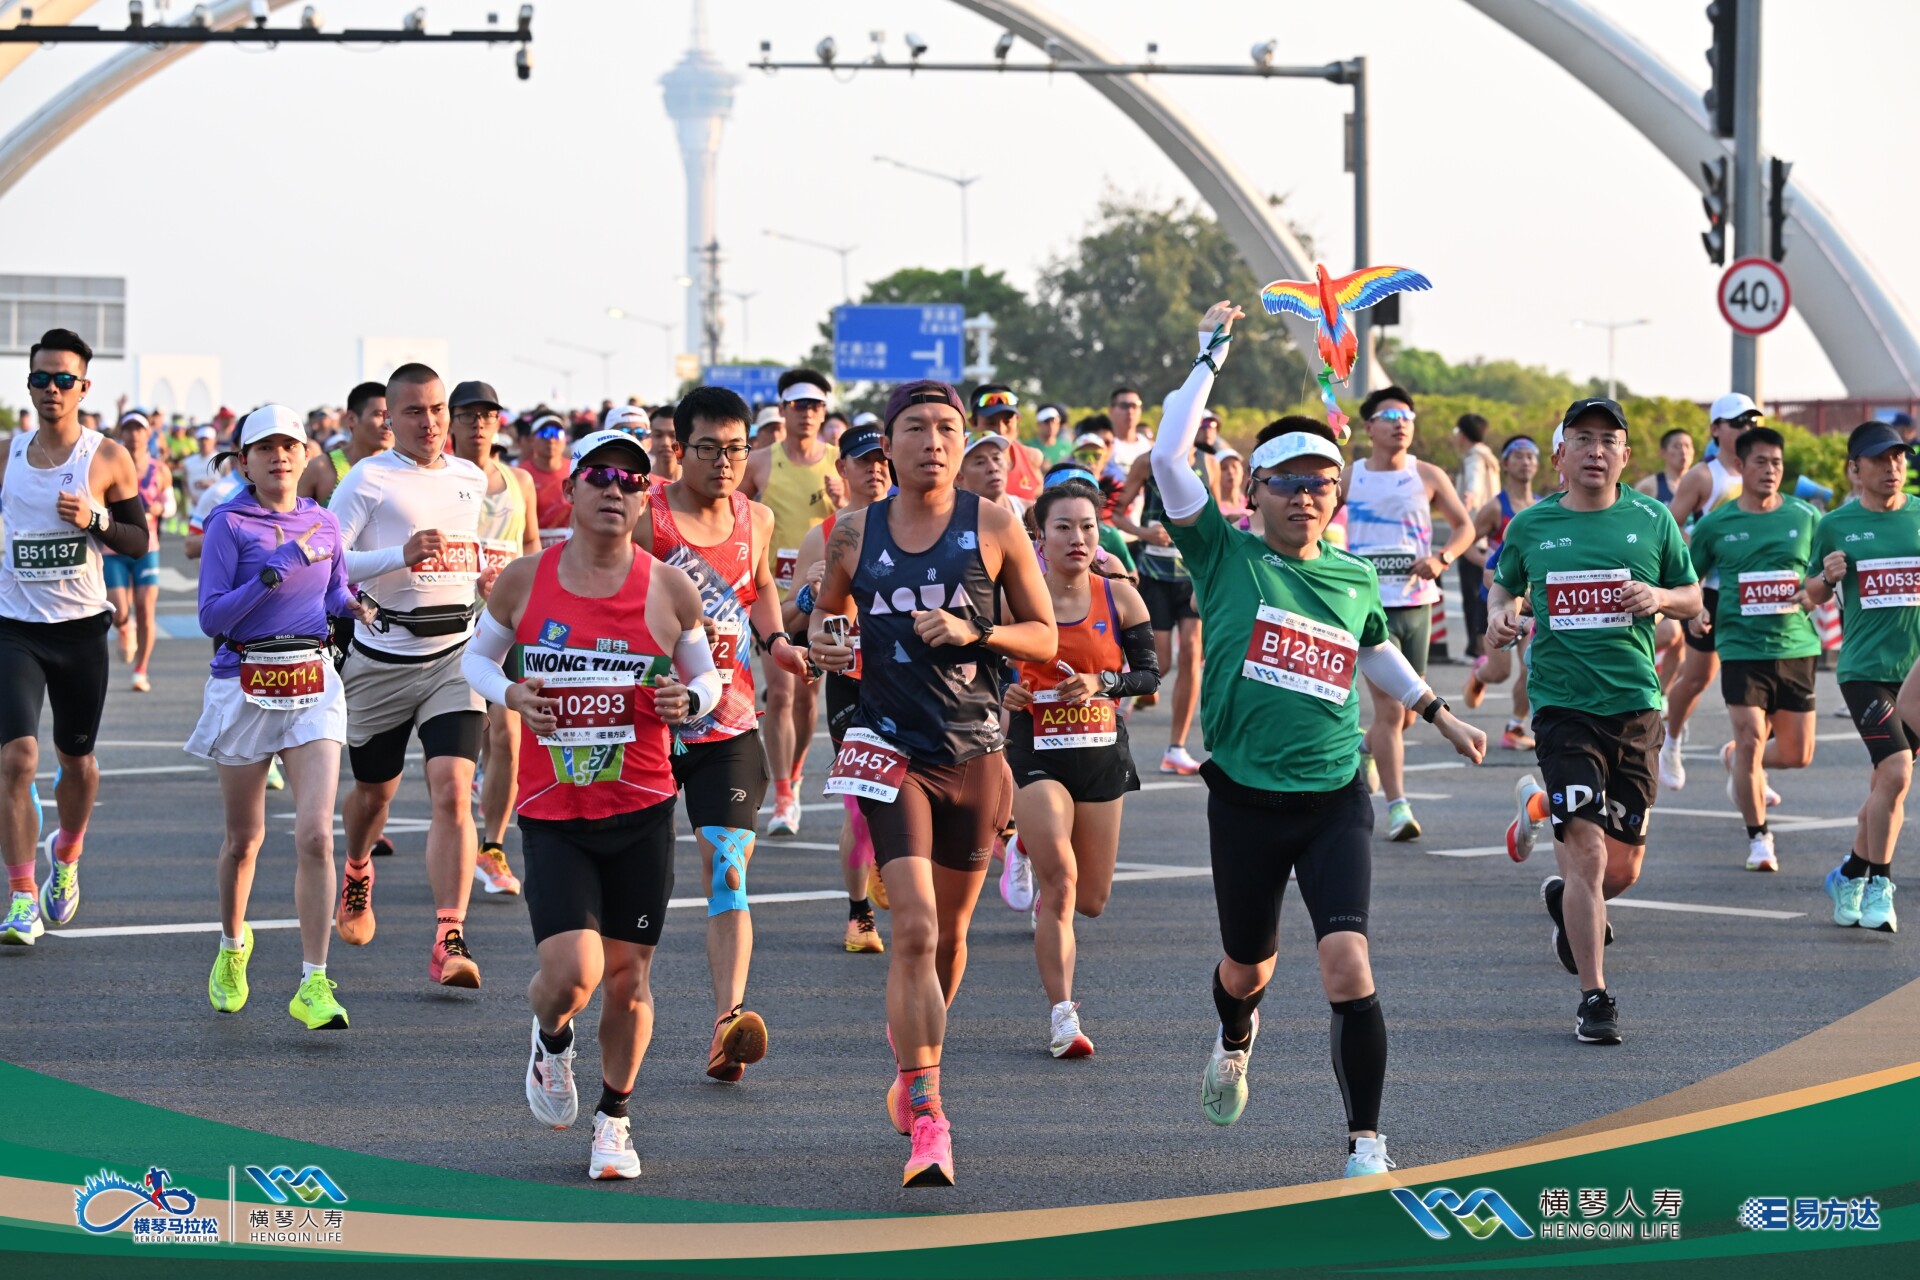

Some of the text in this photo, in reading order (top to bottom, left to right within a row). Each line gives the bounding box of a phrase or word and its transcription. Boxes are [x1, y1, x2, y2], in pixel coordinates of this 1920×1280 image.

[19, 543, 79, 560] B51137
[1372, 557, 1411, 570] 50209
[1865, 572, 1920, 589] A10533
[870, 583, 978, 615] AQUA
[1555, 588, 1623, 606] A10199
[1745, 583, 1796, 598] A10499
[1261, 630, 1346, 674] B12616
[525, 652, 646, 680] KWONG TUNG
[250, 666, 318, 687] A20114
[1041, 706, 1111, 725] A20039
